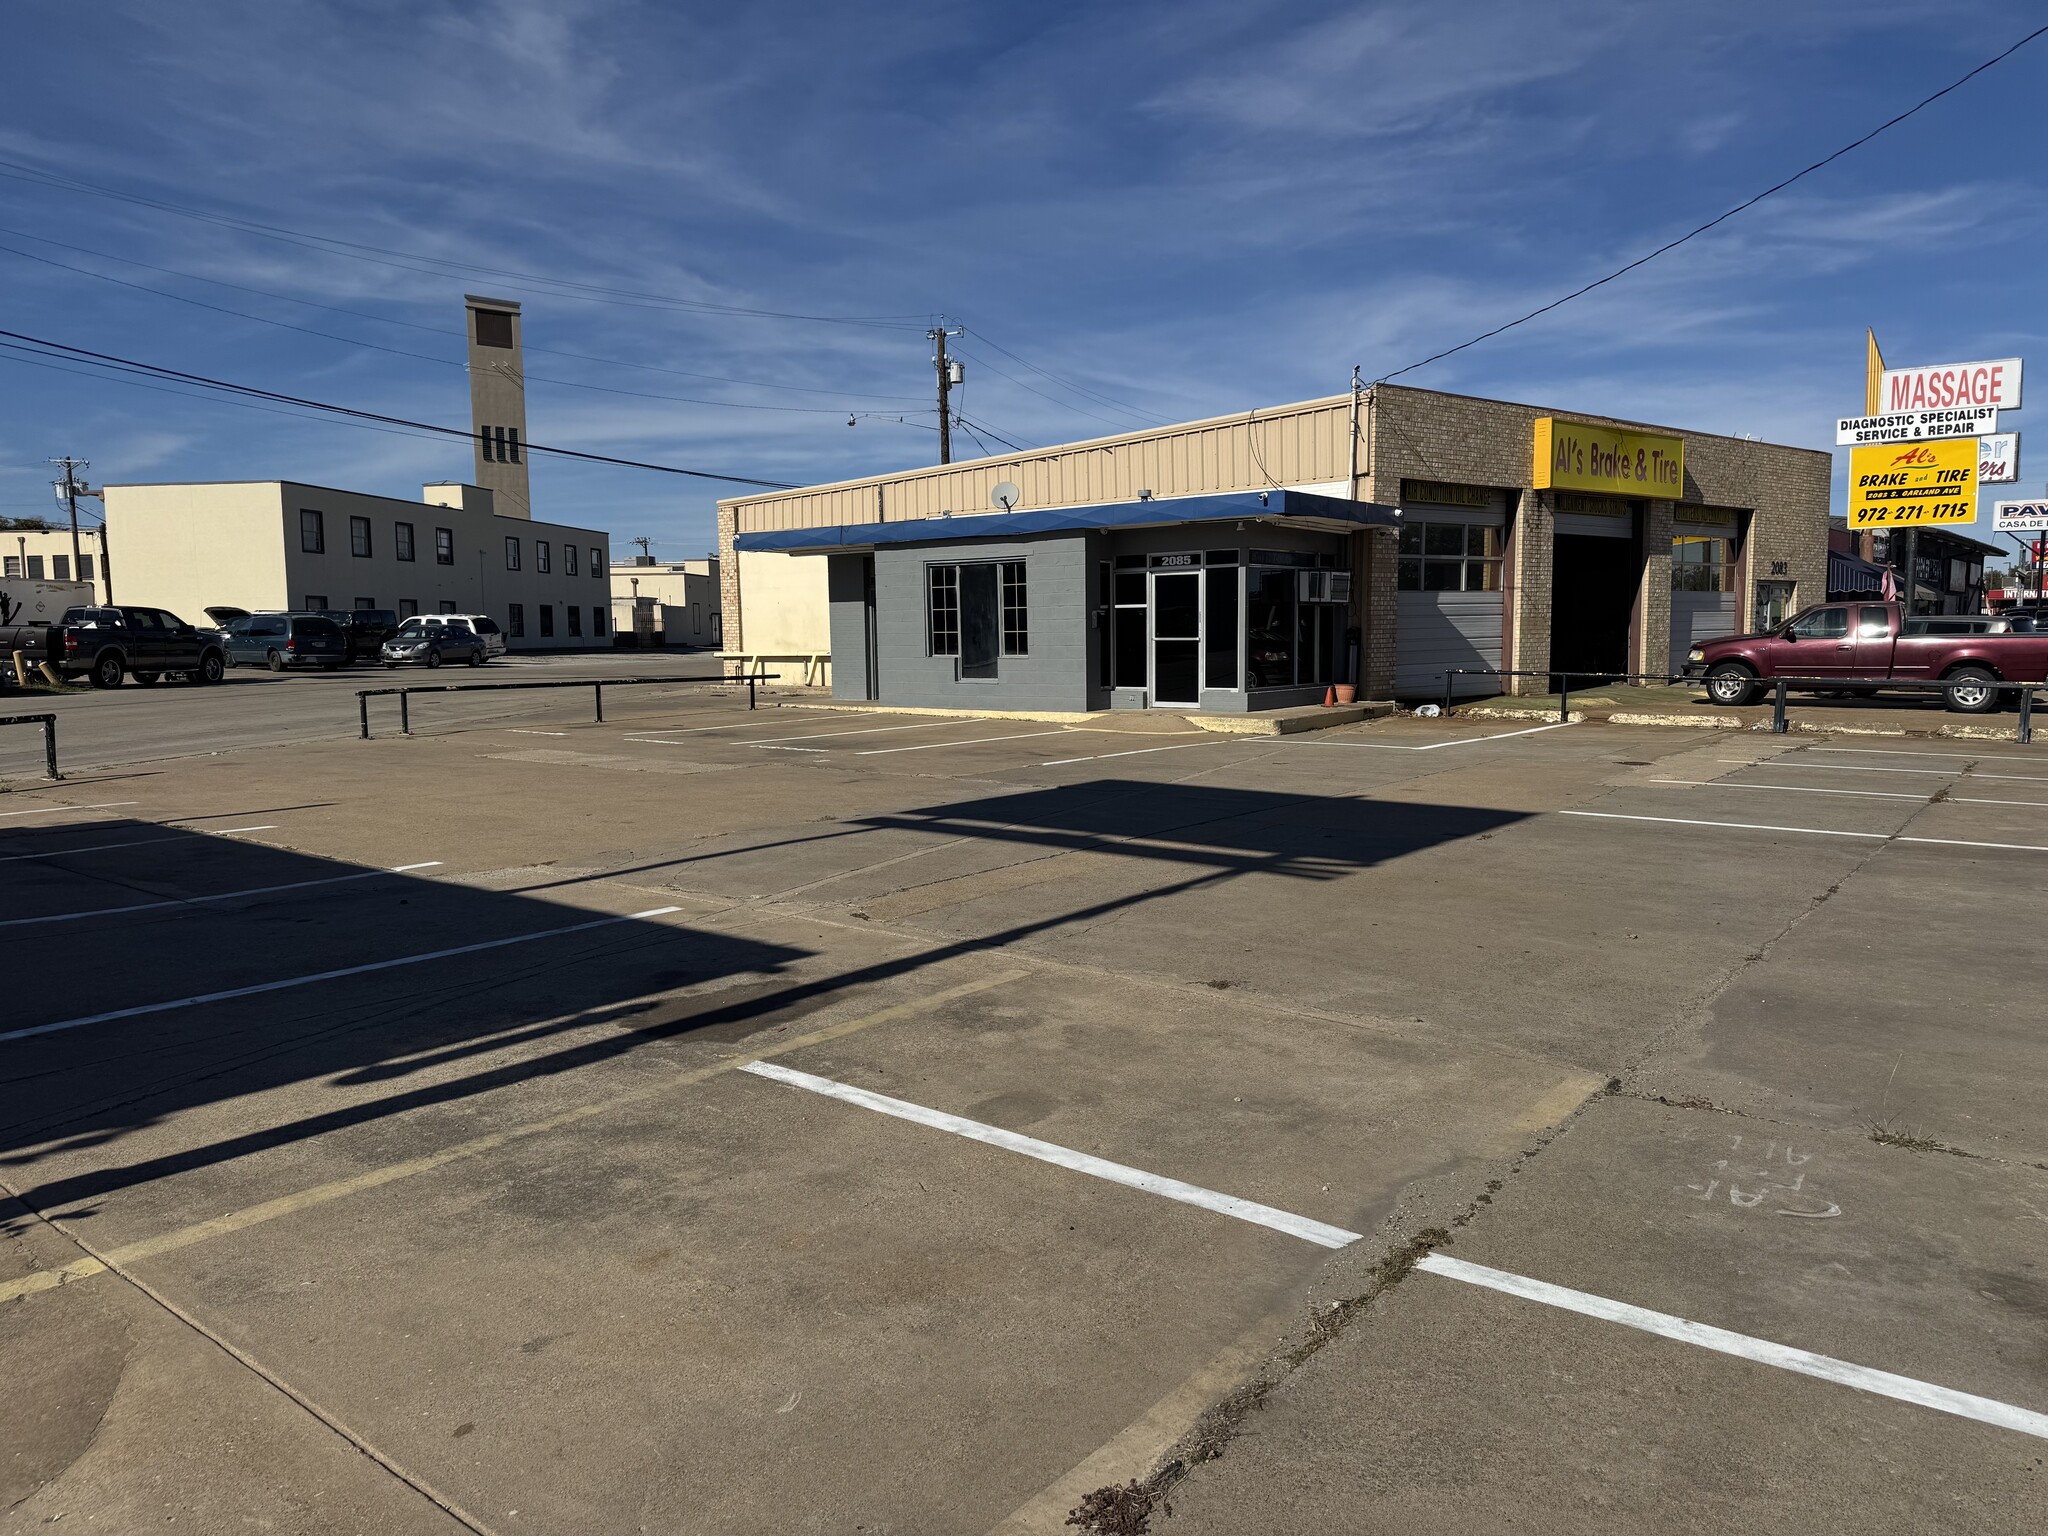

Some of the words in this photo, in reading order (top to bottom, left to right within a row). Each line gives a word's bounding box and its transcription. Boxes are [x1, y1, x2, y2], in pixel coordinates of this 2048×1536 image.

[1891, 366, 2003, 411] MASSAGE
[1840, 414, 1915, 431] DIAGNOSTIC
[1920, 408, 1995, 424] SPECIALIST
[1856, 427, 1908, 442] SERVICE
[1913, 426, 1922, 437] &
[1928, 422, 1975, 436] REPAIR
[1554, 436, 1583, 475] Al's
[1590, 442, 1631, 480] Brake
[1635, 448, 1647, 481] &
[1651, 449, 1678, 485] Tire
[1890, 447, 1937, 467] Al's
[1859, 473, 1909, 487] BRAKE
[1936, 469, 1970, 483] TIRE
[1901, 488, 1940, 497] GARLAND
[1941, 486, 1960, 494] AVE
[1999, 520, 2027, 529] CASA
[2030, 520, 2044, 528] DE
[1161, 555, 1192, 566] 2085
